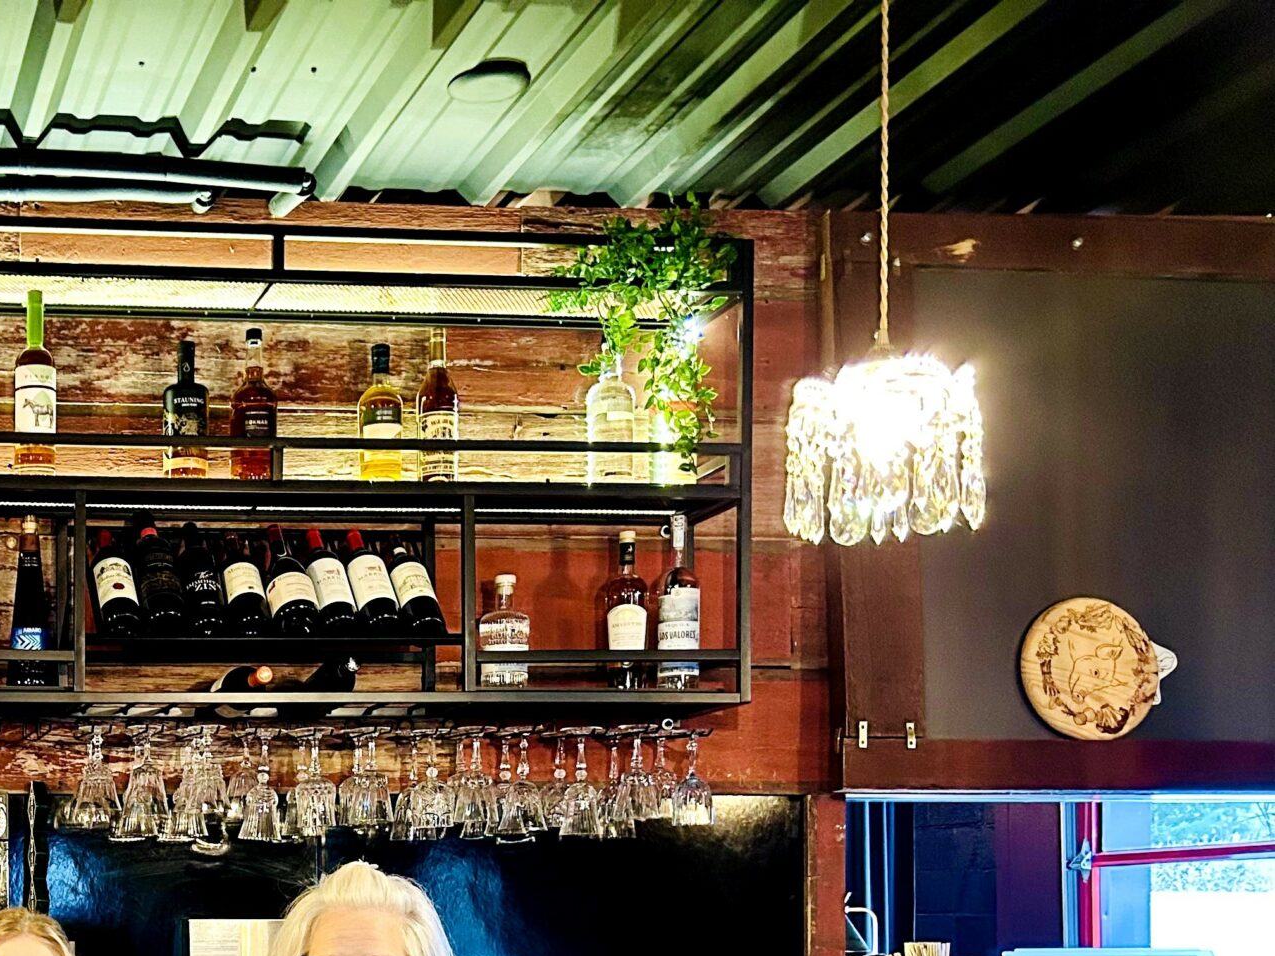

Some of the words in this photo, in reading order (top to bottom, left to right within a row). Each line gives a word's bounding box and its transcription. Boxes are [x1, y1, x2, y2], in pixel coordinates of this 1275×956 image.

[173, 396, 204, 405] STAUNING
[194, 583, 218, 592] ZIN
[659, 631, 669, 641] LOS
[669, 630, 696, 640] VALORES
